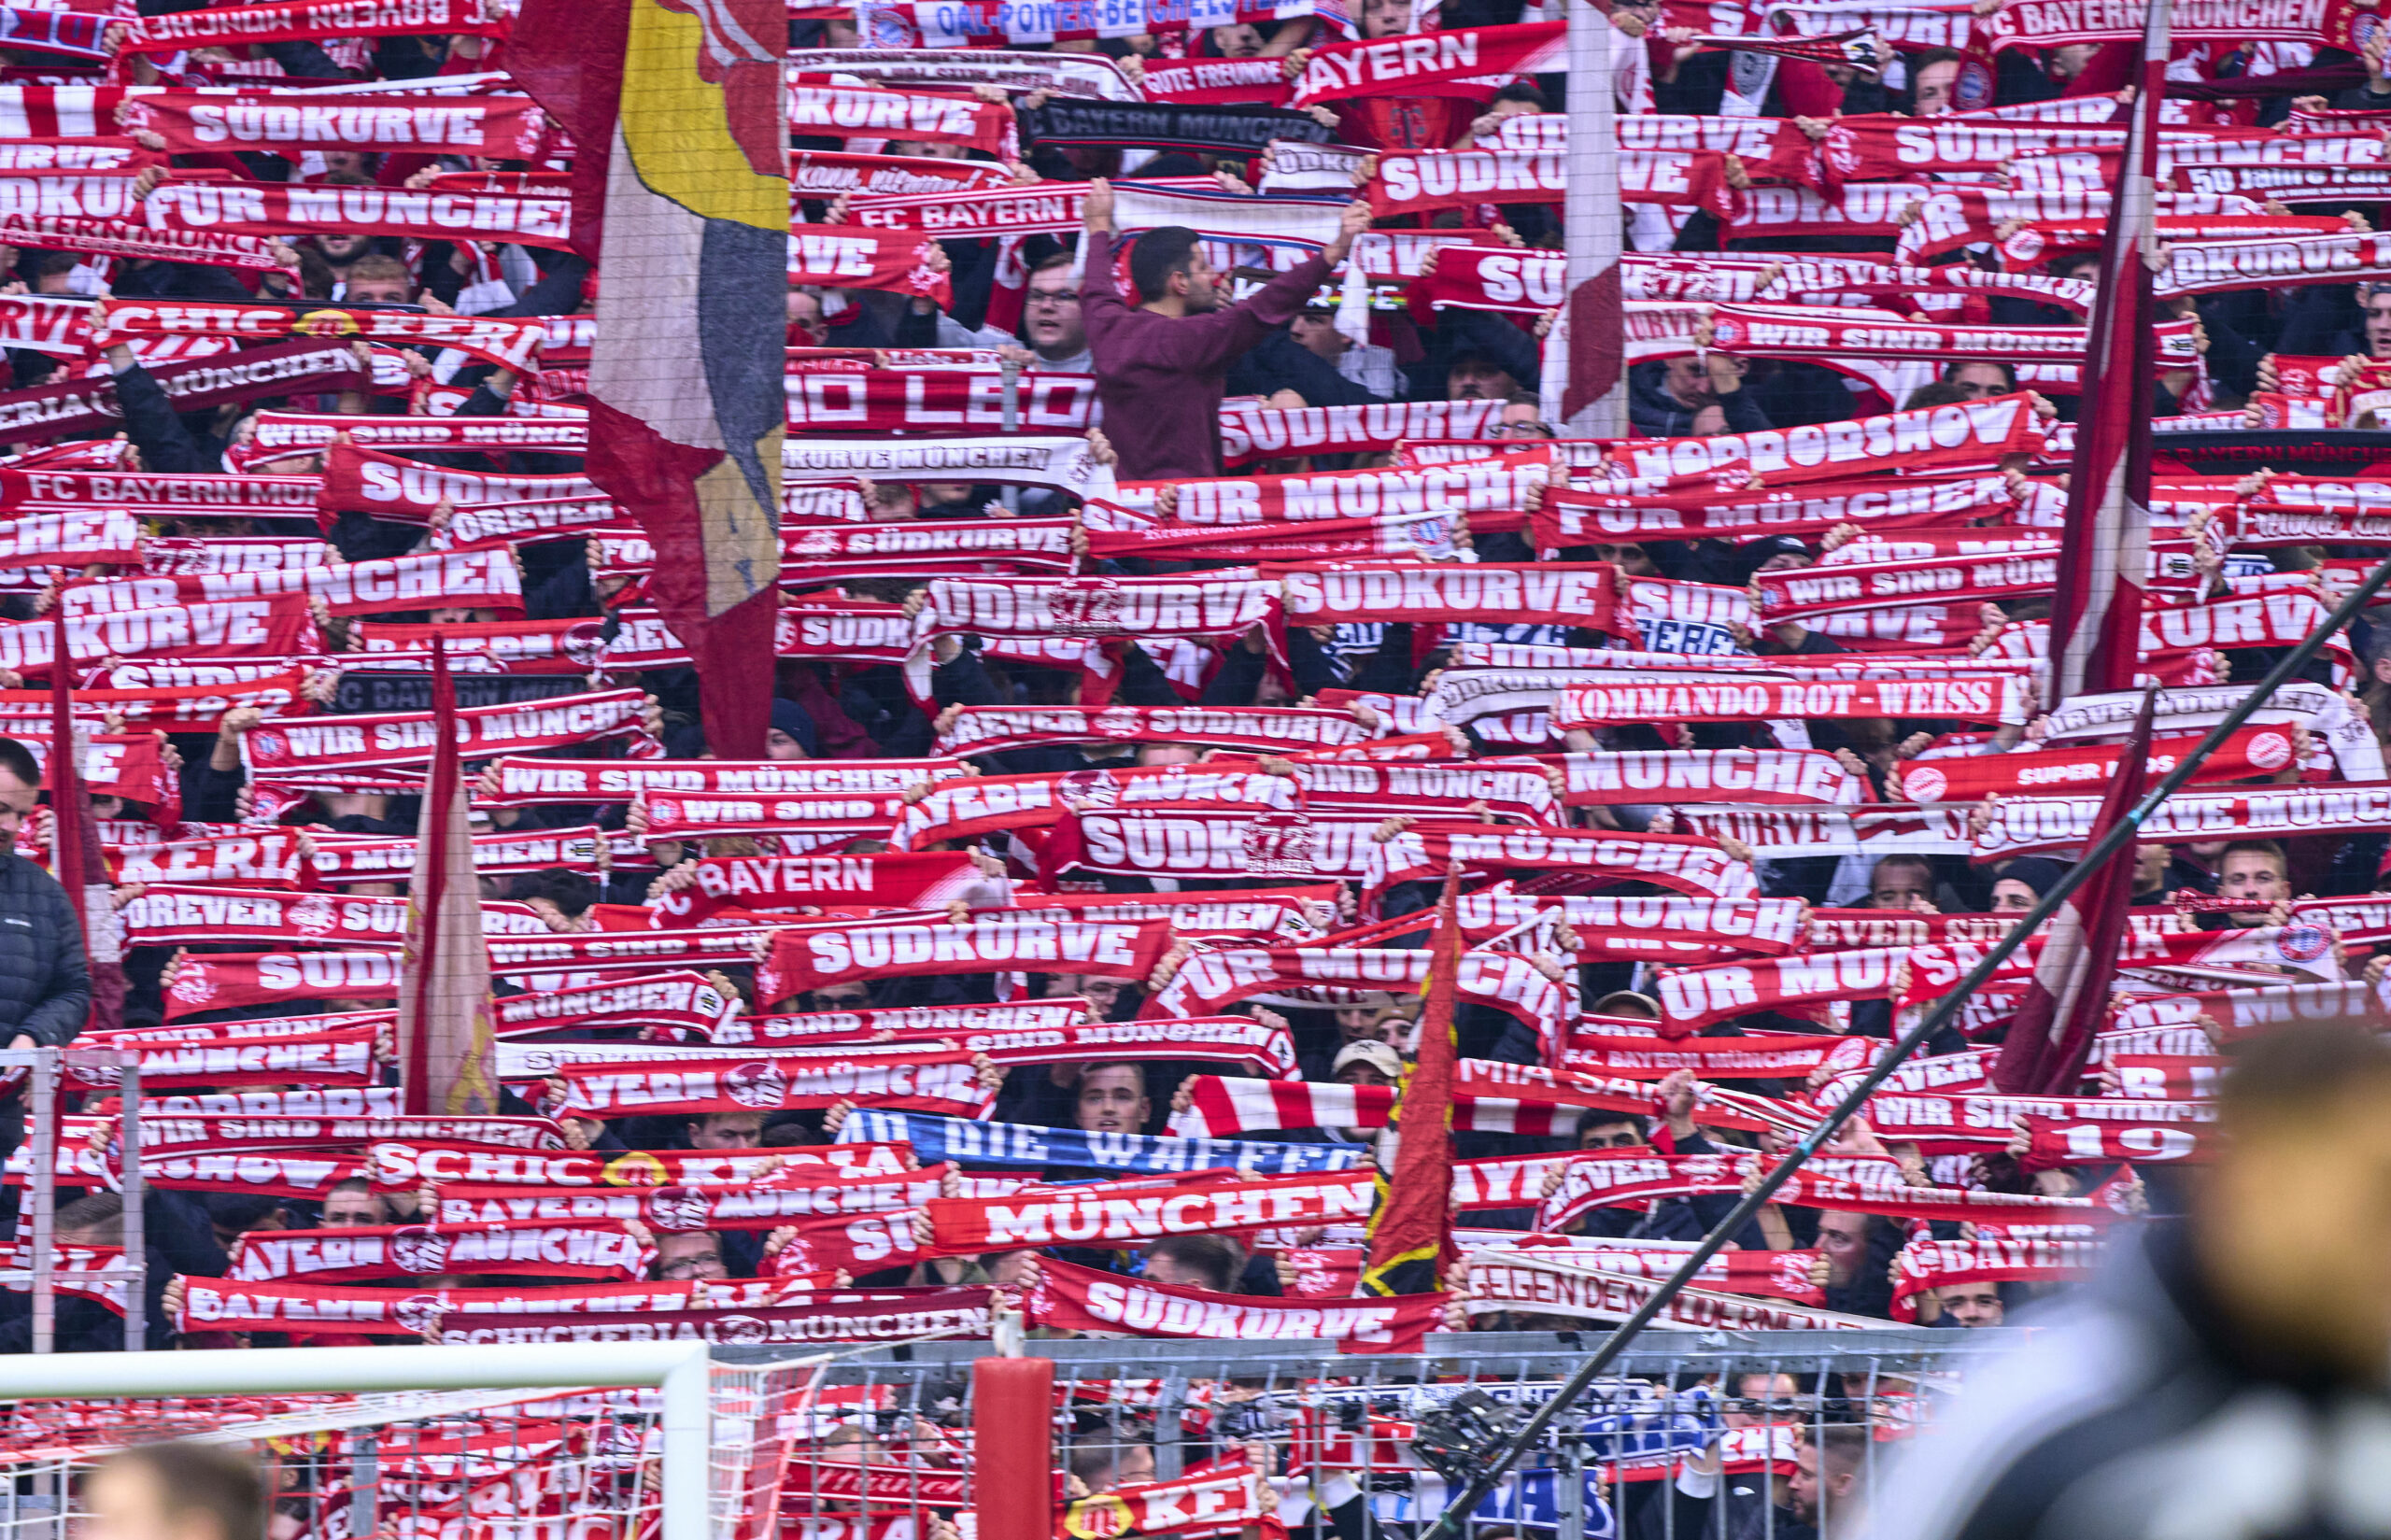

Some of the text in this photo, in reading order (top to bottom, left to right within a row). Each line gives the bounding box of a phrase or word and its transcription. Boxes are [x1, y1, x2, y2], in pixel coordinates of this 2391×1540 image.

[2022, 2, 2145, 34] BAYERN
[1145, 61, 1282, 94] GUTE FREUNDE
[190, 98, 485, 145] SÜDKURVE
[1380, 149, 1692, 201] SÜDKUVE
[0, 177, 134, 216] DKU
[860, 196, 1068, 229] FC BAYERN
[109, 307, 286, 333] CHIC
[164, 348, 361, 399] MÜNCHEN
[463, 422, 588, 444] MÜNC
[1220, 400, 1506, 458] SÜDKURV
[1633, 400, 2023, 477] HORRORSHOW
[898, 445, 1053, 470] MÜNCHEN
[30, 475, 240, 505] FC BAYERN
[1558, 499, 1683, 535] FÜR
[847, 528, 1071, 556] SÜDKURVE
[1292, 563, 1601, 615] SÜDKURVE
[1633, 581, 1756, 622] SÜD
[1785, 576, 1862, 605] WIR
[1873, 569, 1962, 596] SIND
[1565, 683, 1770, 719] KOMMANDO
[1780, 683, 1857, 715] ROT
[1876, 681, 1992, 714] WEISS
[284, 725, 365, 758] WIR
[504, 765, 928, 793] WIR SIND MÜNCHEN
[2018, 762, 2100, 785] SUPER
[684, 799, 875, 824] WIR SIND
[700, 857, 872, 897] BAYERN
[129, 894, 283, 929] OREVER
[1566, 896, 1798, 943] MÜNCH
[584, 940, 689, 959] SIND
[808, 923, 1140, 975] SÜDKURVE
[505, 982, 695, 1023] MÜNCHEN
[1659, 966, 1758, 1021] ÜR
[766, 1005, 1071, 1036] SIND MÜNCHEN
[140, 1041, 369, 1076] MÜNCHEN
[1464, 1058, 1556, 1089] MIA
[1608, 1051, 1704, 1069] BAYERN
[1708, 1050, 1823, 1068] MÜNCHEN
[1873, 1095, 1955, 1128] WIR
[164, 1154, 340, 1190] SHOW
[377, 1142, 595, 1185] SCHIC
[985, 1180, 1376, 1244] MÜNCHEN
[1470, 1263, 1575, 1307] GEGEN
[190, 1286, 385, 1321] BAYERN
[1085, 1281, 1399, 1344] SÜDKURVE
[770, 1307, 994, 1341] MÜNCHEN
